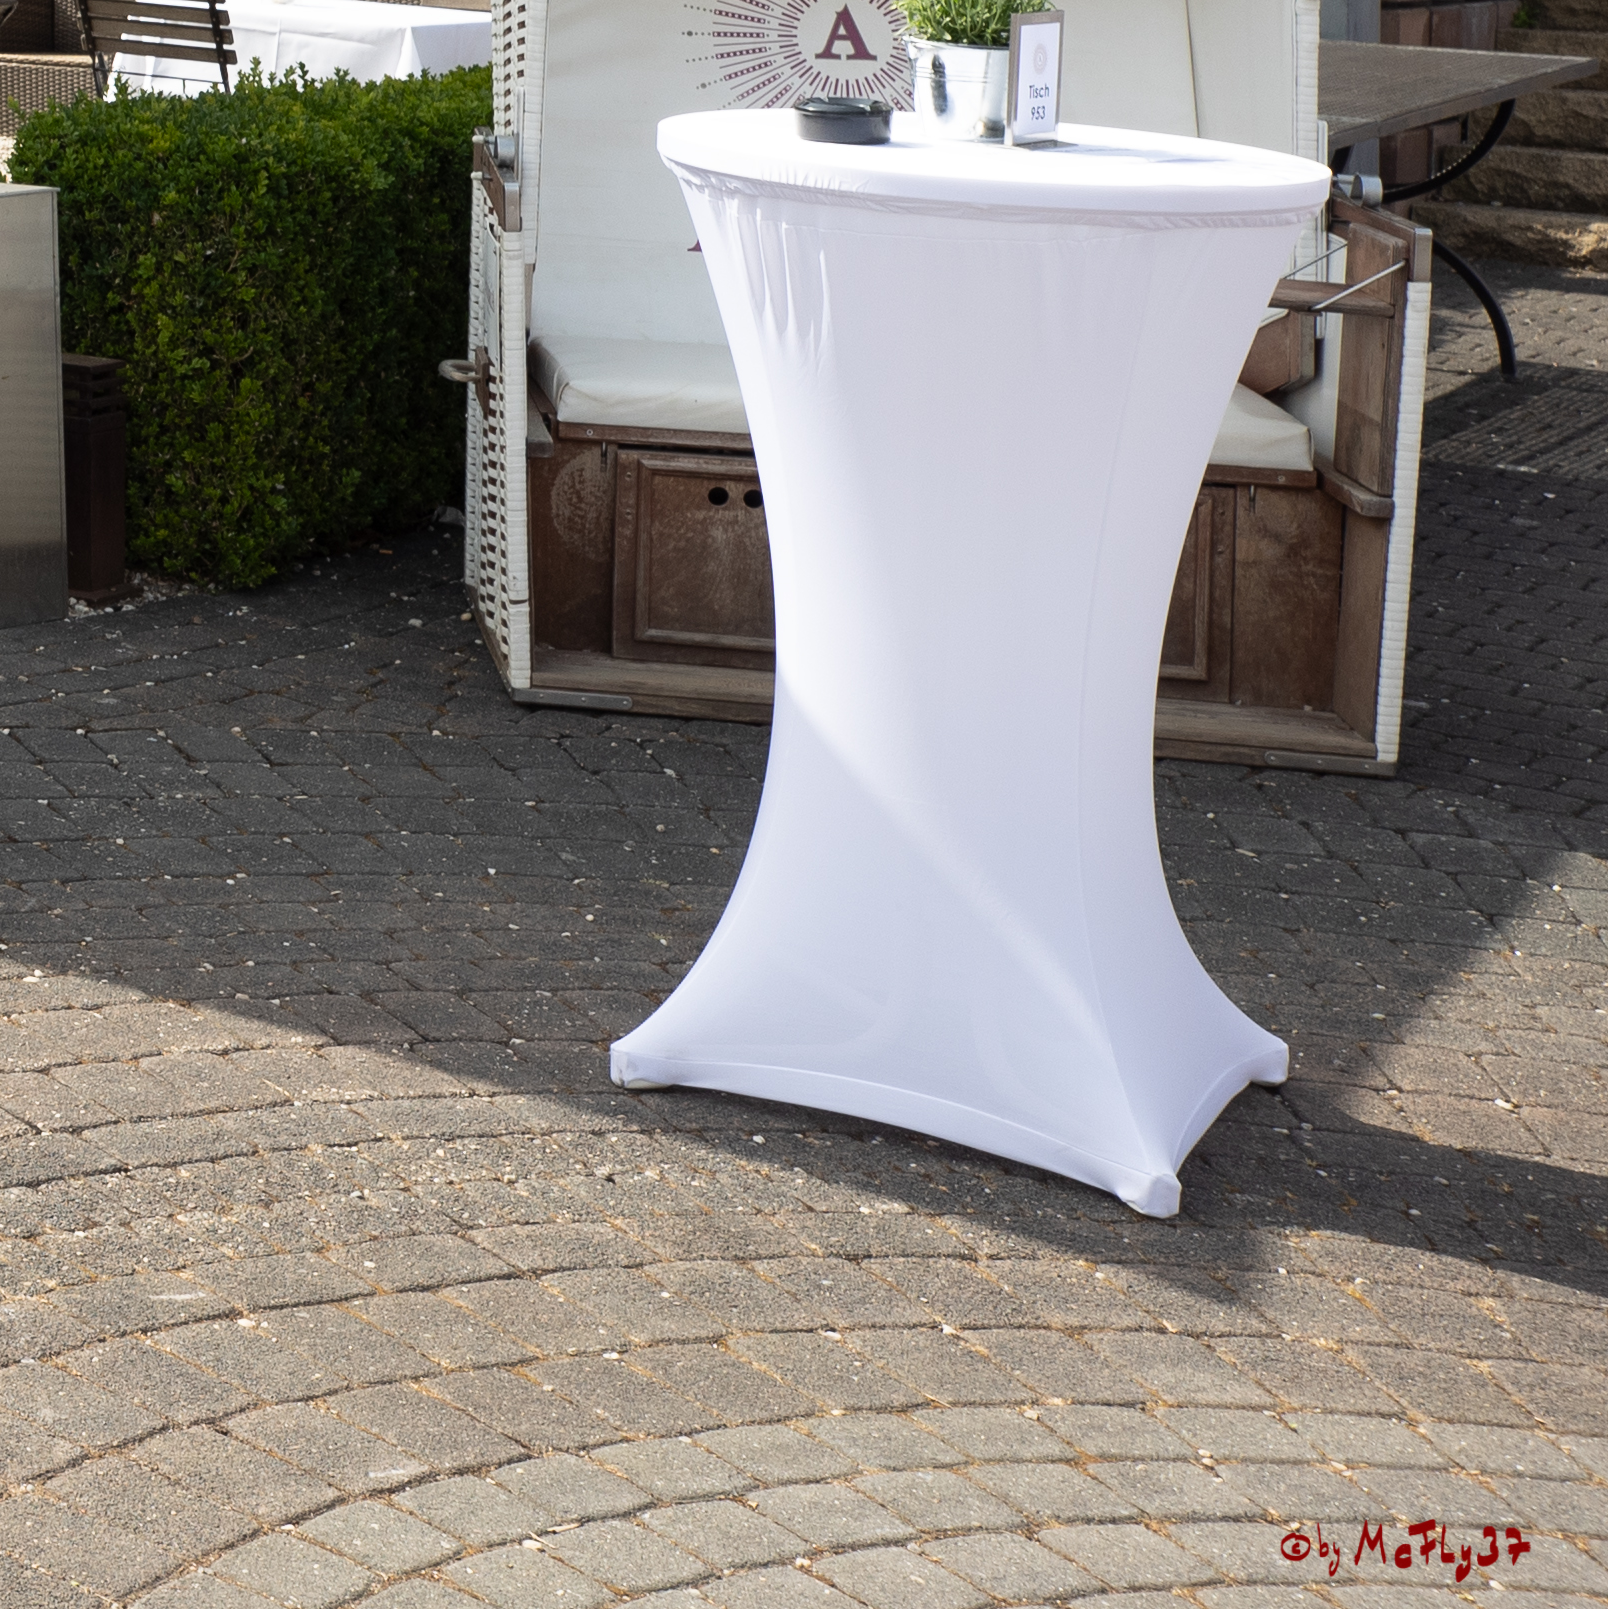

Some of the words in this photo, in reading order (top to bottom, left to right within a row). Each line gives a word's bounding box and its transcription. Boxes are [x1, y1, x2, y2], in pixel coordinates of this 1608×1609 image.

[815, 3, 877, 61] A
[1029, 83, 1050, 99] Tisch
[1031, 106, 1046, 121] 953
